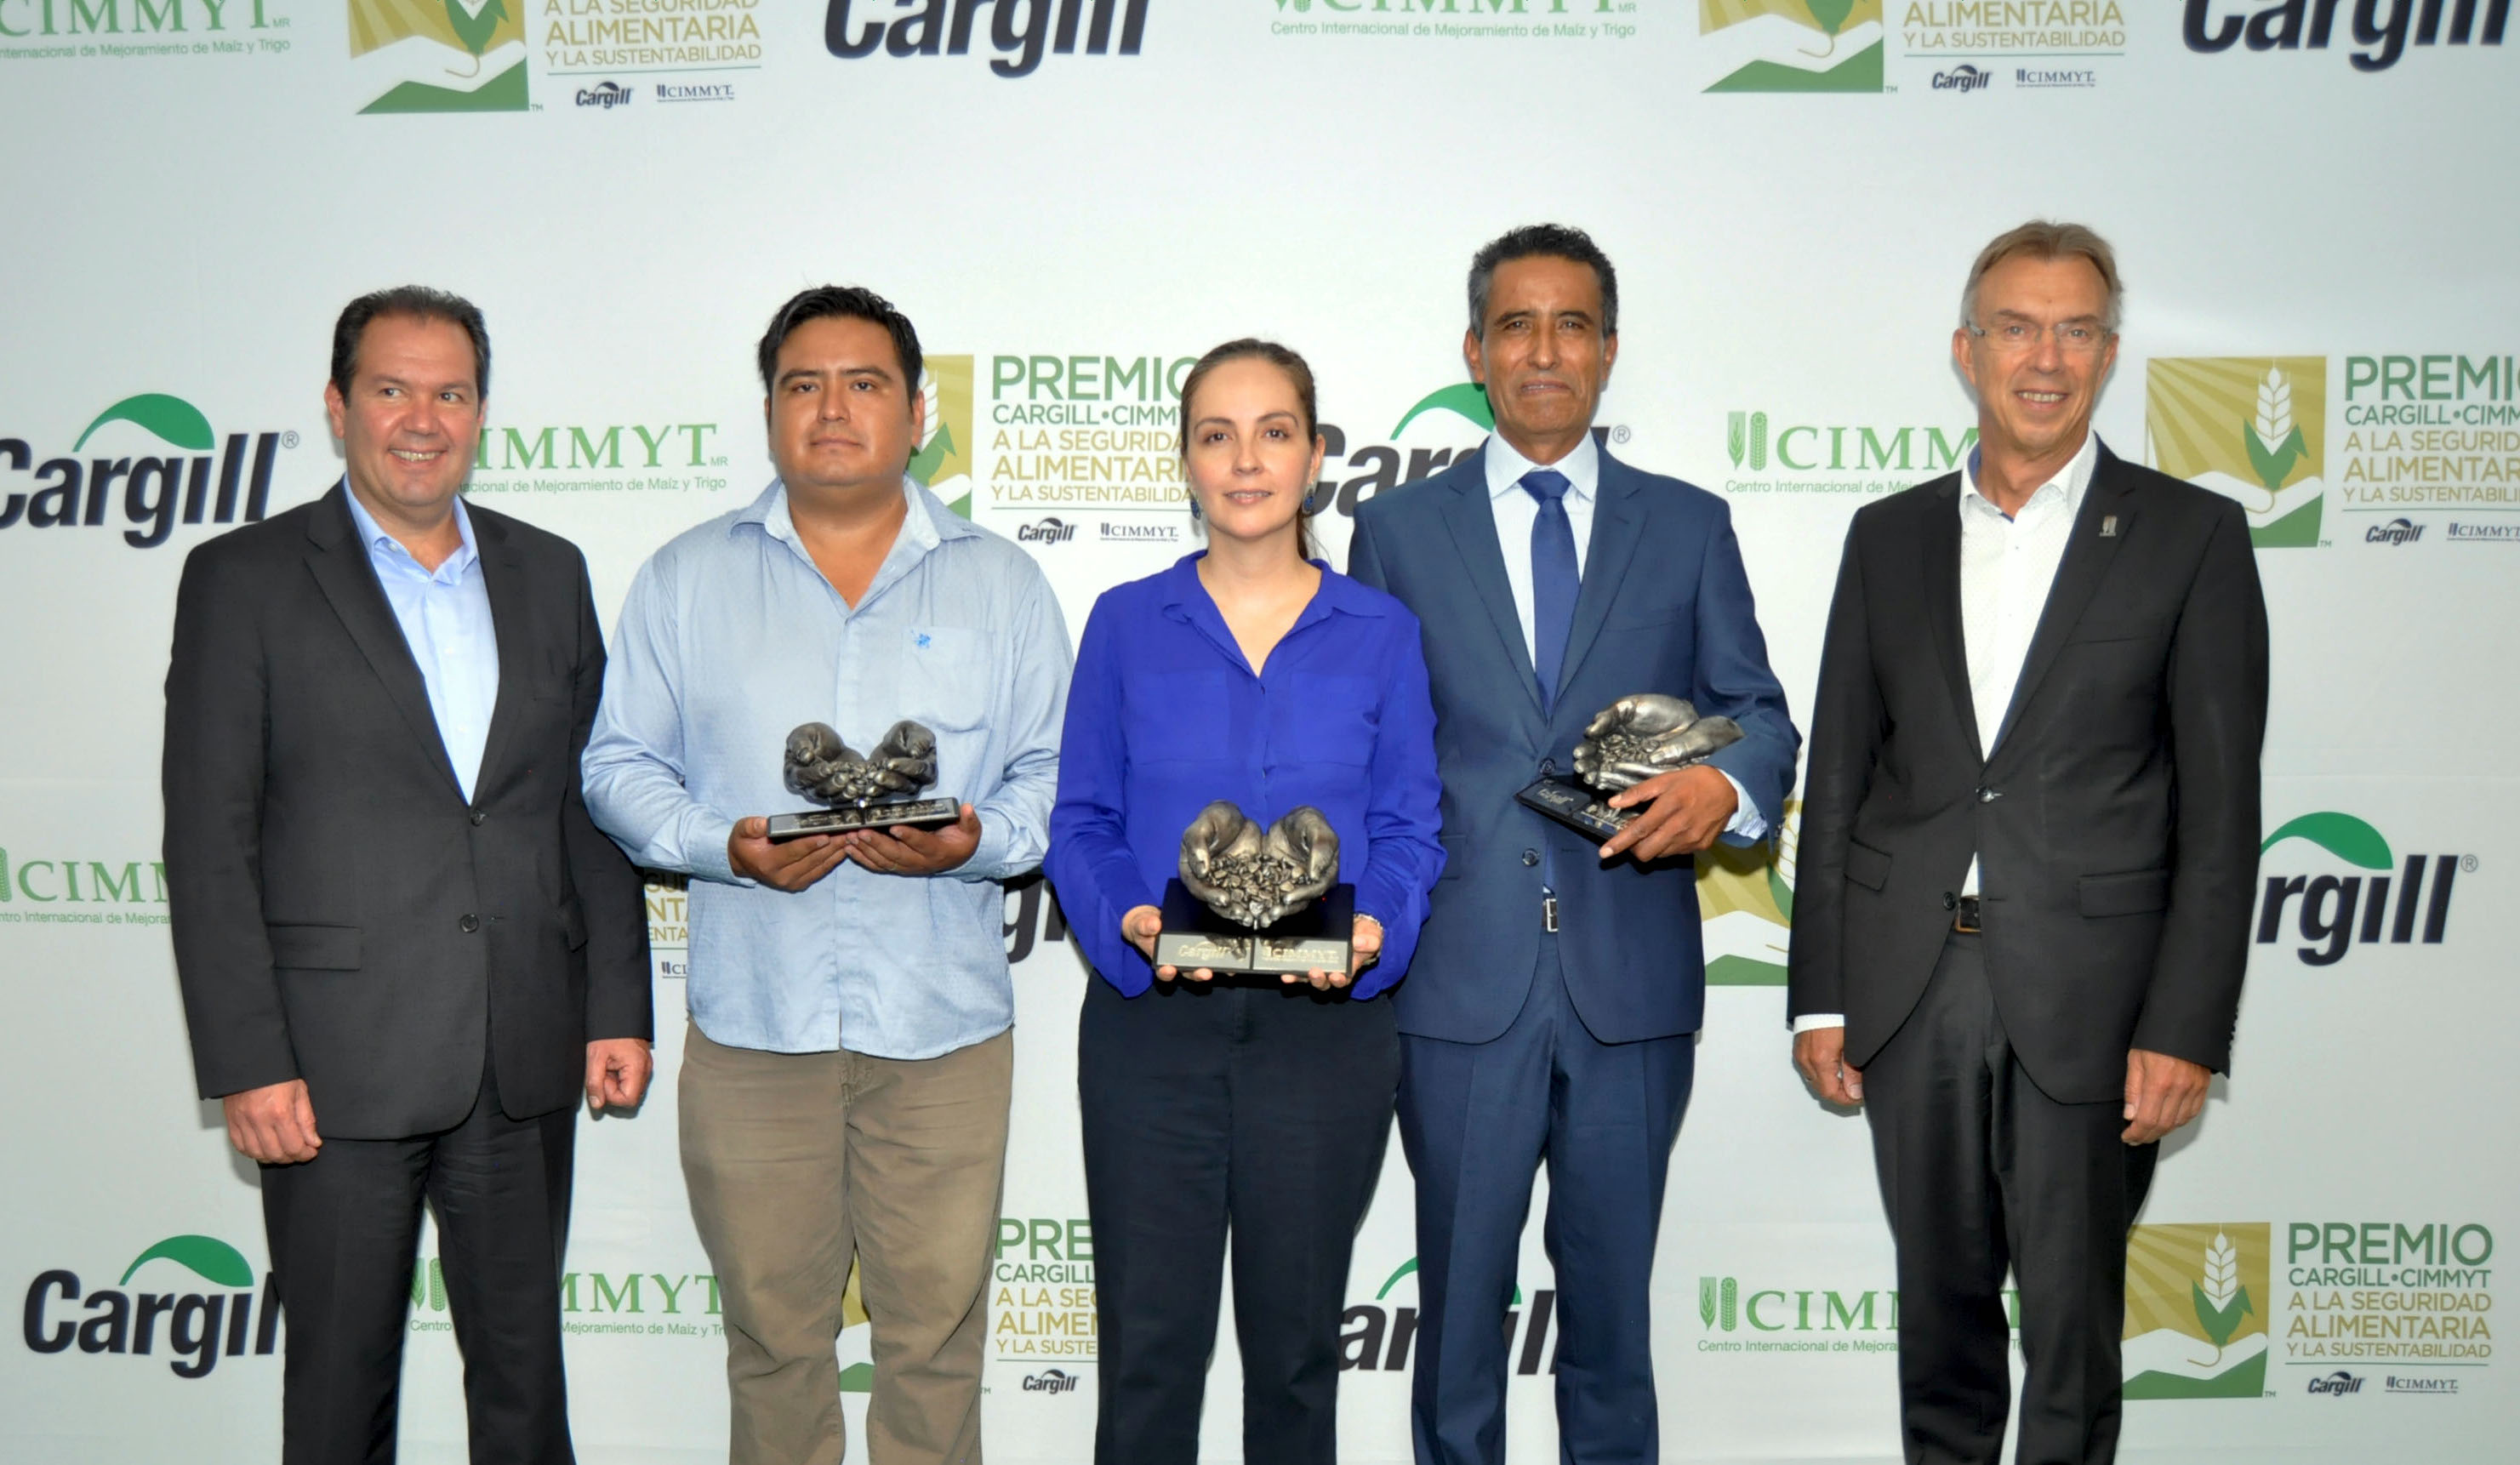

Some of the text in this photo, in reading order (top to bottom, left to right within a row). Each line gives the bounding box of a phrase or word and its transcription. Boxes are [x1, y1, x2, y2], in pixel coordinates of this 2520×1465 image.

[544, 0, 562, 16] A
[570, 0, 603, 16] LA
[1903, 0, 2124, 27] ALIMENTARIA
[545, 14, 761, 46] ALIMENTARIA
[1271, 22, 1317, 35] Centro
[1321, 22, 1409, 36] Internacional
[1413, 23, 1430, 36] de
[1435, 24, 1528, 39] Mejoramiento
[1531, 24, 1549, 37] de
[1590, 26, 1599, 39] y
[1603, 23, 1635, 39] Trigo
[1903, 31, 2125, 48] Y LA SUSTENTABILIDAD
[0, 46, 76, 60] nternacional
[80, 46, 96, 57] de
[100, 43, 189, 59] Mejoramiento
[193, 43, 209, 54] de
[247, 43, 254, 55] y
[259, 39, 290, 52] Trigo
[546, 44, 761, 66] Y LA SUSTENTABILIDAD
[1931, 71, 1991, 93] Cargill
[2027, 71, 2094, 83] CIMMYT
[576, 87, 634, 109] Cargill
[667, 84, 733, 98] CIMMYT
[2345, 356, 2520, 402] PREMI
[992, 404, 1180, 425] CARGILL•CIMM
[2346, 405, 2520, 425] CARGILL•CIMM
[474, 425, 716, 470] IMMYT
[992, 430, 1183, 452] A LA SEGURID
[1776, 426, 1979, 470] CIMM
[2344, 430, 2520, 452] A LA SEGURID
[991, 455, 1183, 482] ALIMENTARI
[2343, 457, 2520, 482] ALIMENTAR
[0, 432, 280, 549] Cargill
[459, 481, 509, 493] acional
[512, 479, 529, 492] de
[534, 479, 624, 494] Mejoramiento
[627, 477, 644, 491] de
[682, 480, 690, 493] y
[694, 476, 727, 491] Trigo
[991, 486, 1193, 503] Y LA SUSTENTABILIDA
[1725, 481, 1771, 493] Centro
[1776, 481, 1862, 493] Internacional
[1867, 481, 1884, 493] de
[2344, 487, 2520, 502] Y LA SUSTENTABILI
[1018, 524, 1075, 544] Cargill
[1111, 526, 1173, 537] CIMMYT
[2365, 525, 2424, 545] Cargill
[18, 860, 168, 903] CIM
[0, 914, 21, 923] ntro
[26, 911, 102, 923] Internacional
[105, 912, 122, 924] de
[2256, 854, 2459, 966] rgill
[2288, 1223, 2493, 1266] PREMIO
[995, 1288, 1015, 1307] A
[1022, 1288, 1052, 1307] LA
[2288, 1291, 2492, 1312] A LA SEGURIDAD
[24, 1269, 281, 1378] Cargil
[647, 1323, 664, 1335] de
[700, 1326, 708, 1338] y
[2287, 1315, 2491, 1340] ALIMENTARIA
[996, 1340, 1007, 1353] Y
[1012, 1340, 1035, 1354] LA
[1698, 1340, 1742, 1353] Centro
[1746, 1339, 1828, 1352] Internacional
[1833, 1339, 1849, 1352] de
[2287, 1342, 2492, 1359] Y LA SUSTENTABILIDAD
[1023, 1375, 1076, 1394] Cargill
[2307, 1377, 2363, 1397] Cargill
[2396, 1379, 2458, 1389] CIMMYT
